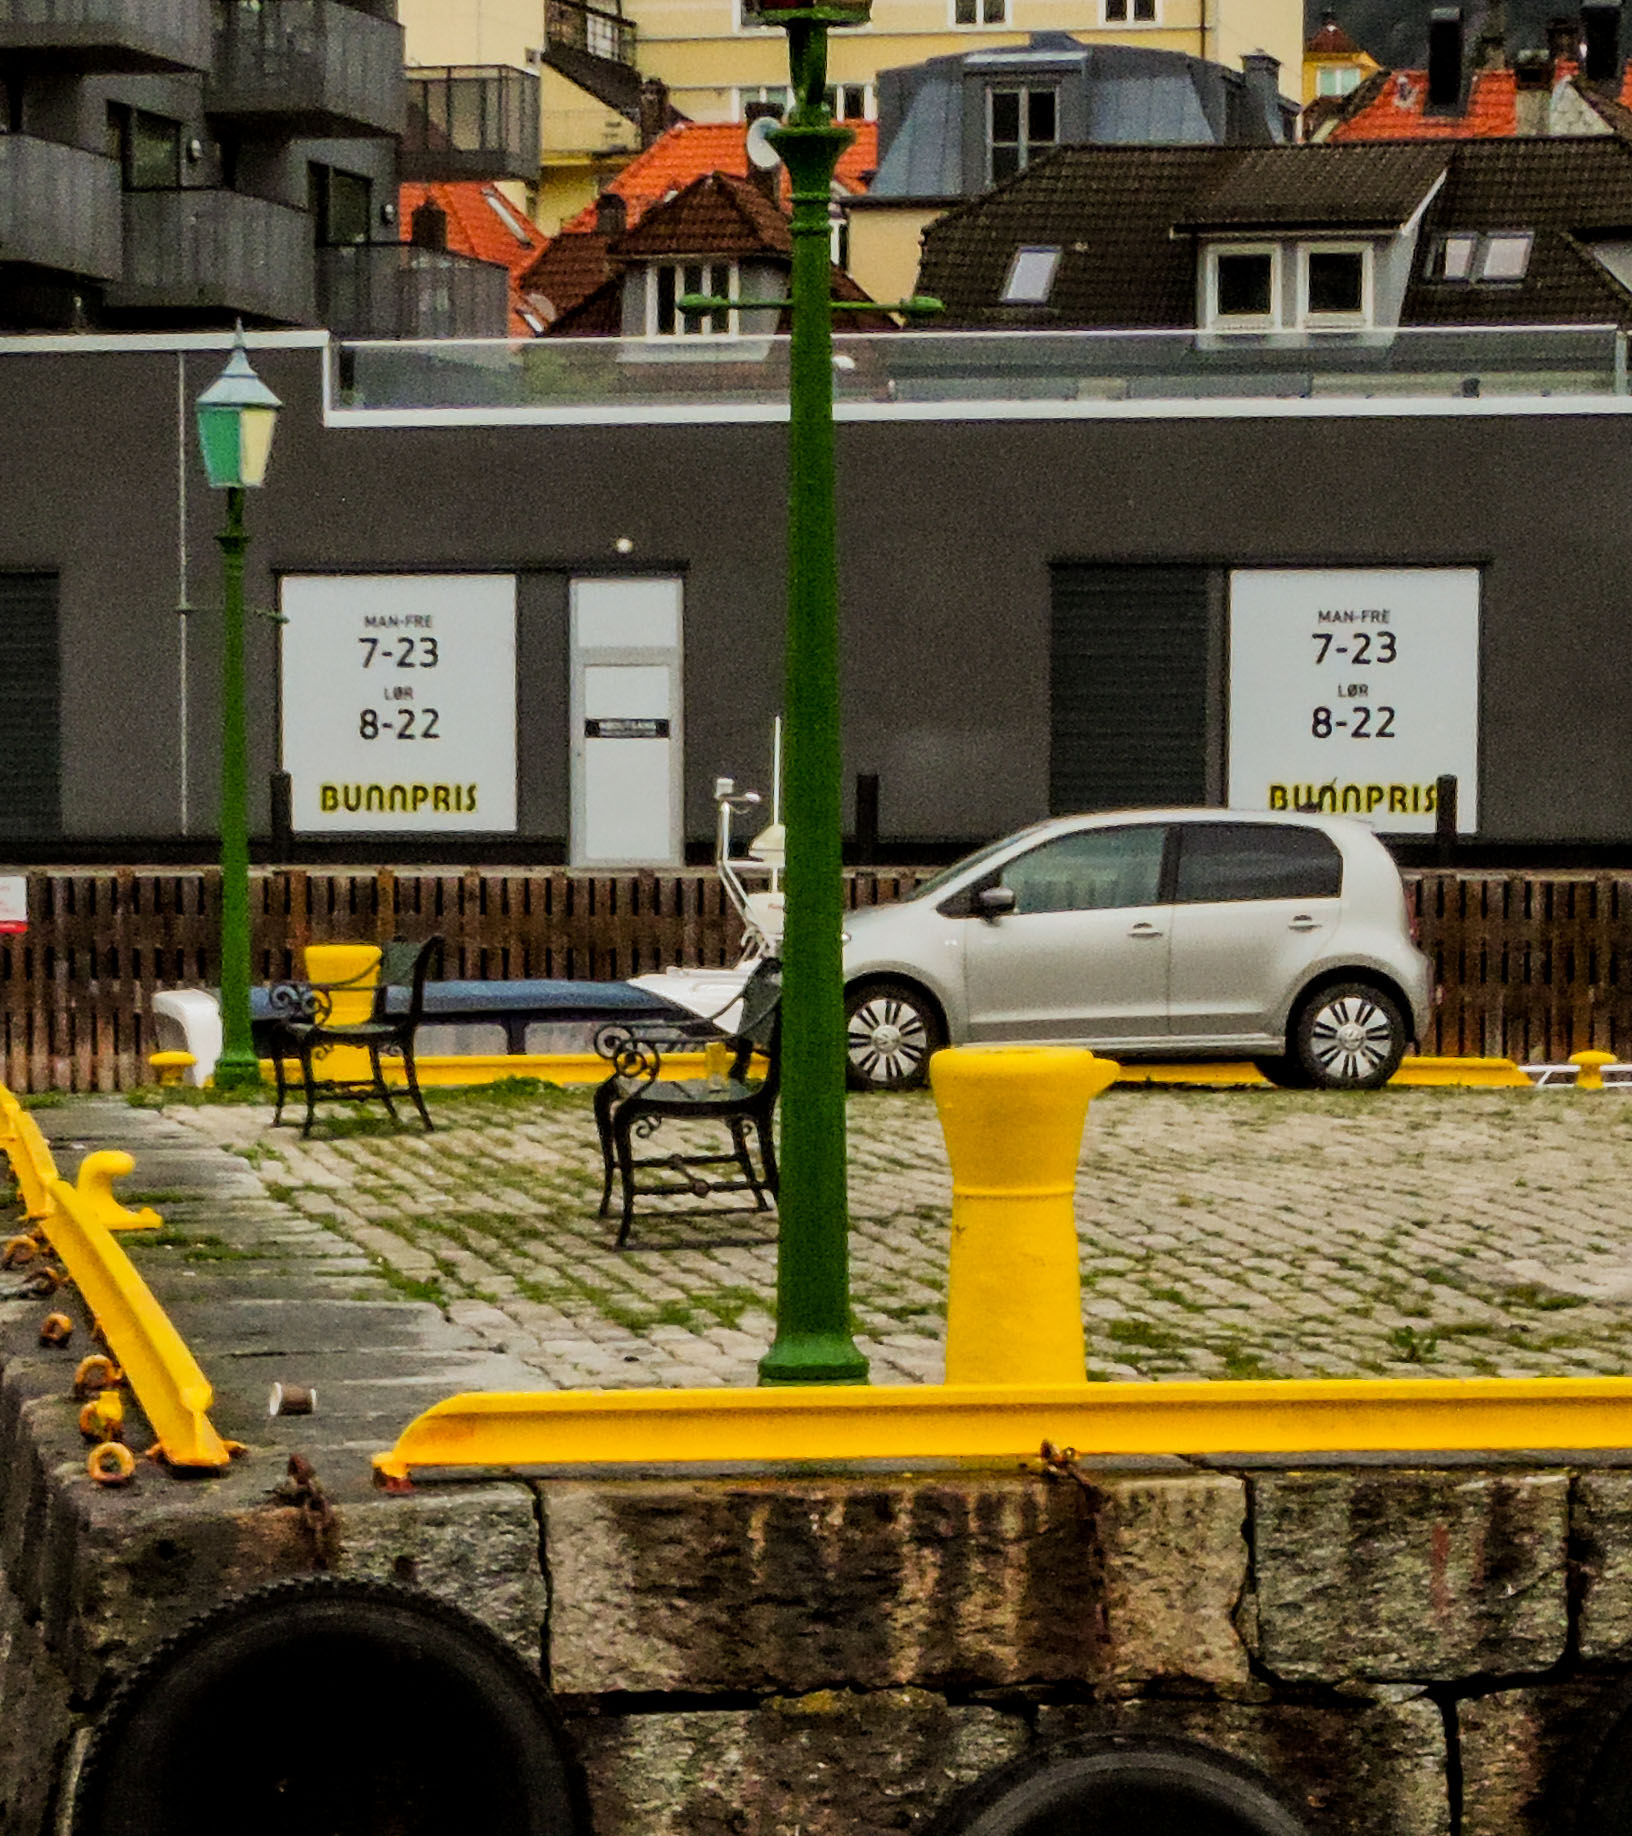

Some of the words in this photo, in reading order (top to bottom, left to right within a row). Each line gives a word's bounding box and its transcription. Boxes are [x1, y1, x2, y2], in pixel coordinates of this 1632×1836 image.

[363, 614, 433, 628] MAN-FRE
[1318, 609, 1391, 625] MAN-FRE
[358, 636, 439, 669] 7-23
[1311, 631, 1398, 665] 7-23
[384, 686, 414, 701] LØR
[1337, 683, 1369, 699] LØR
[359, 708, 440, 740] 8-22
[1311, 706, 1396, 739] 8-22
[320, 783, 478, 813] BUNNPRIS
